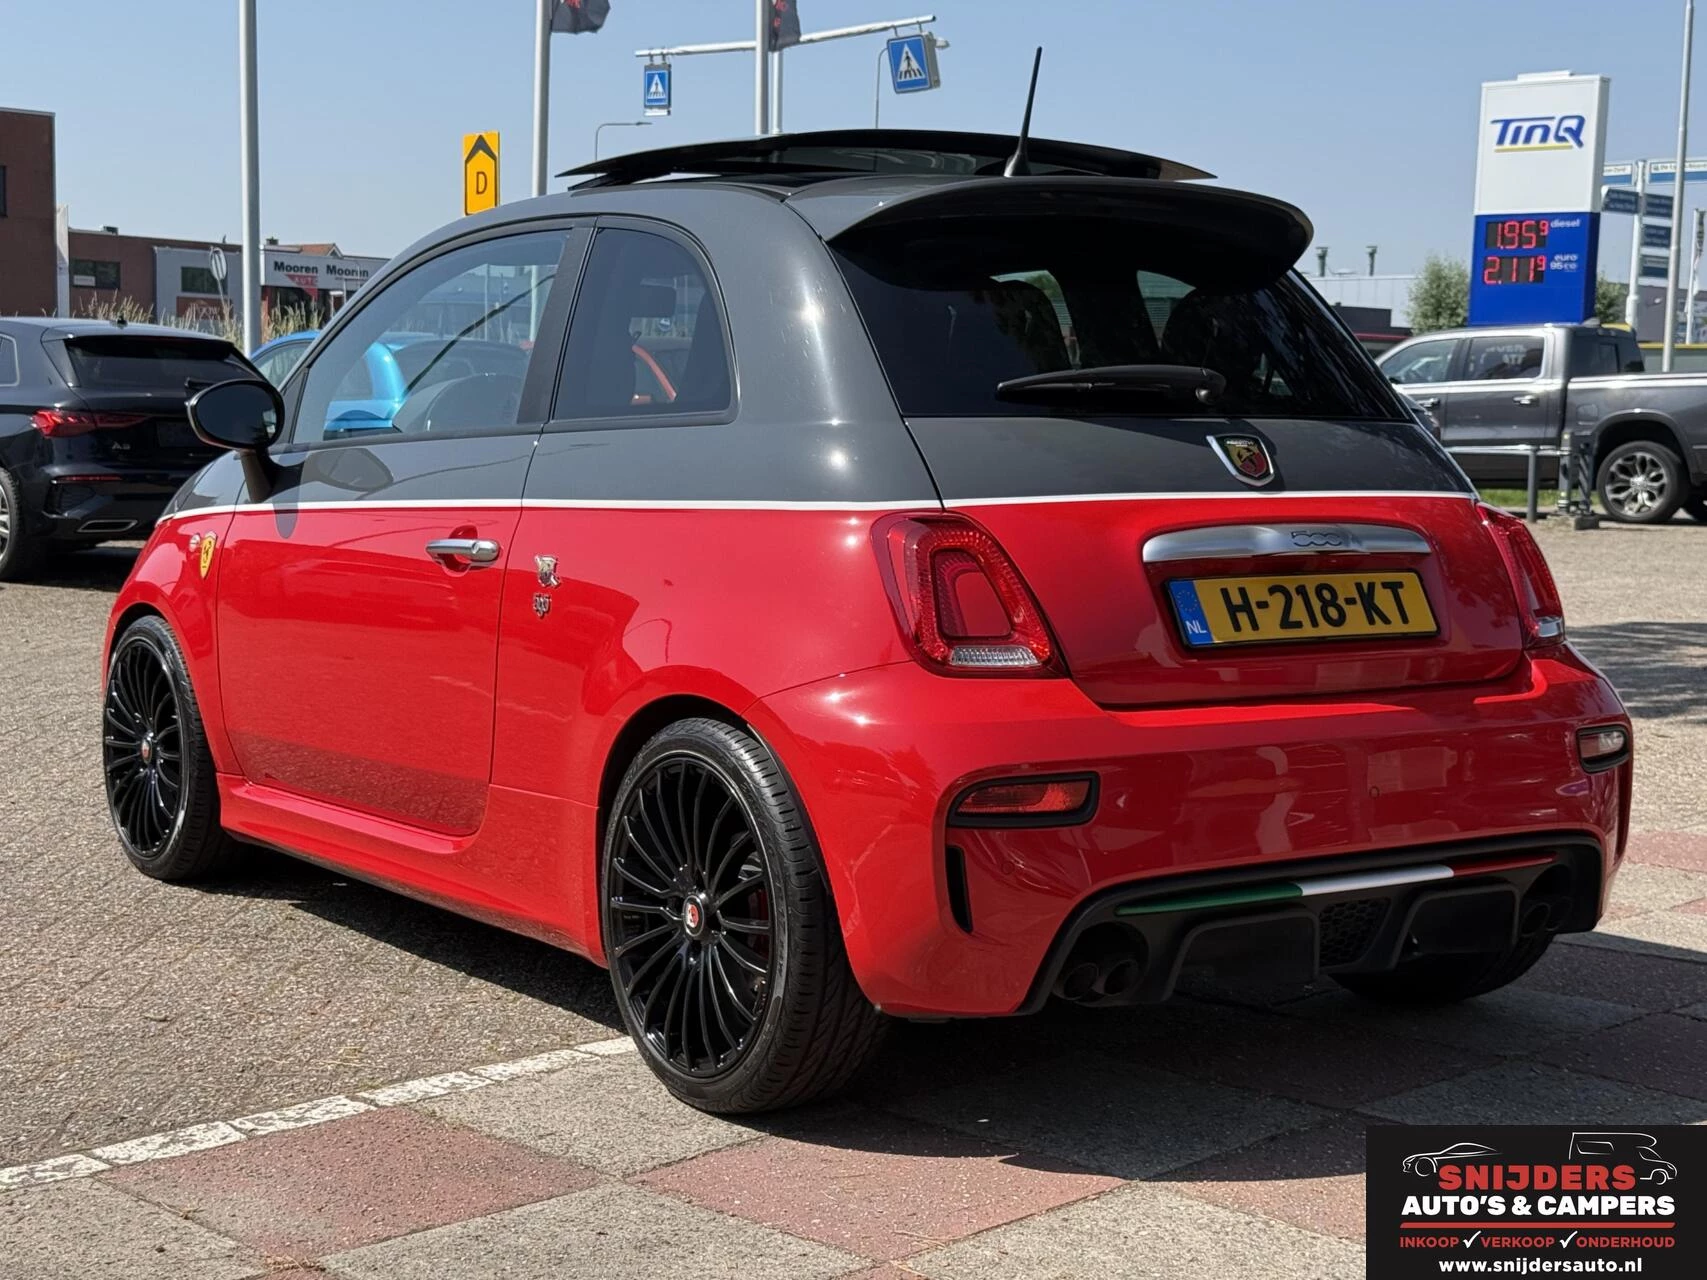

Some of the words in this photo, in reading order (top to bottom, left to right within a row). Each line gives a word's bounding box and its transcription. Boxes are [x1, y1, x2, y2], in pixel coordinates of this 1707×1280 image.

[476, 171, 488, 195] D
[1550, 219, 1580, 228] diesel
[1554, 254, 1578, 262] euro
[274, 261, 319, 274] Mooren
[1220, 581, 1410, 633] H-218-KT
[1185, 619, 1207, 634] NL
